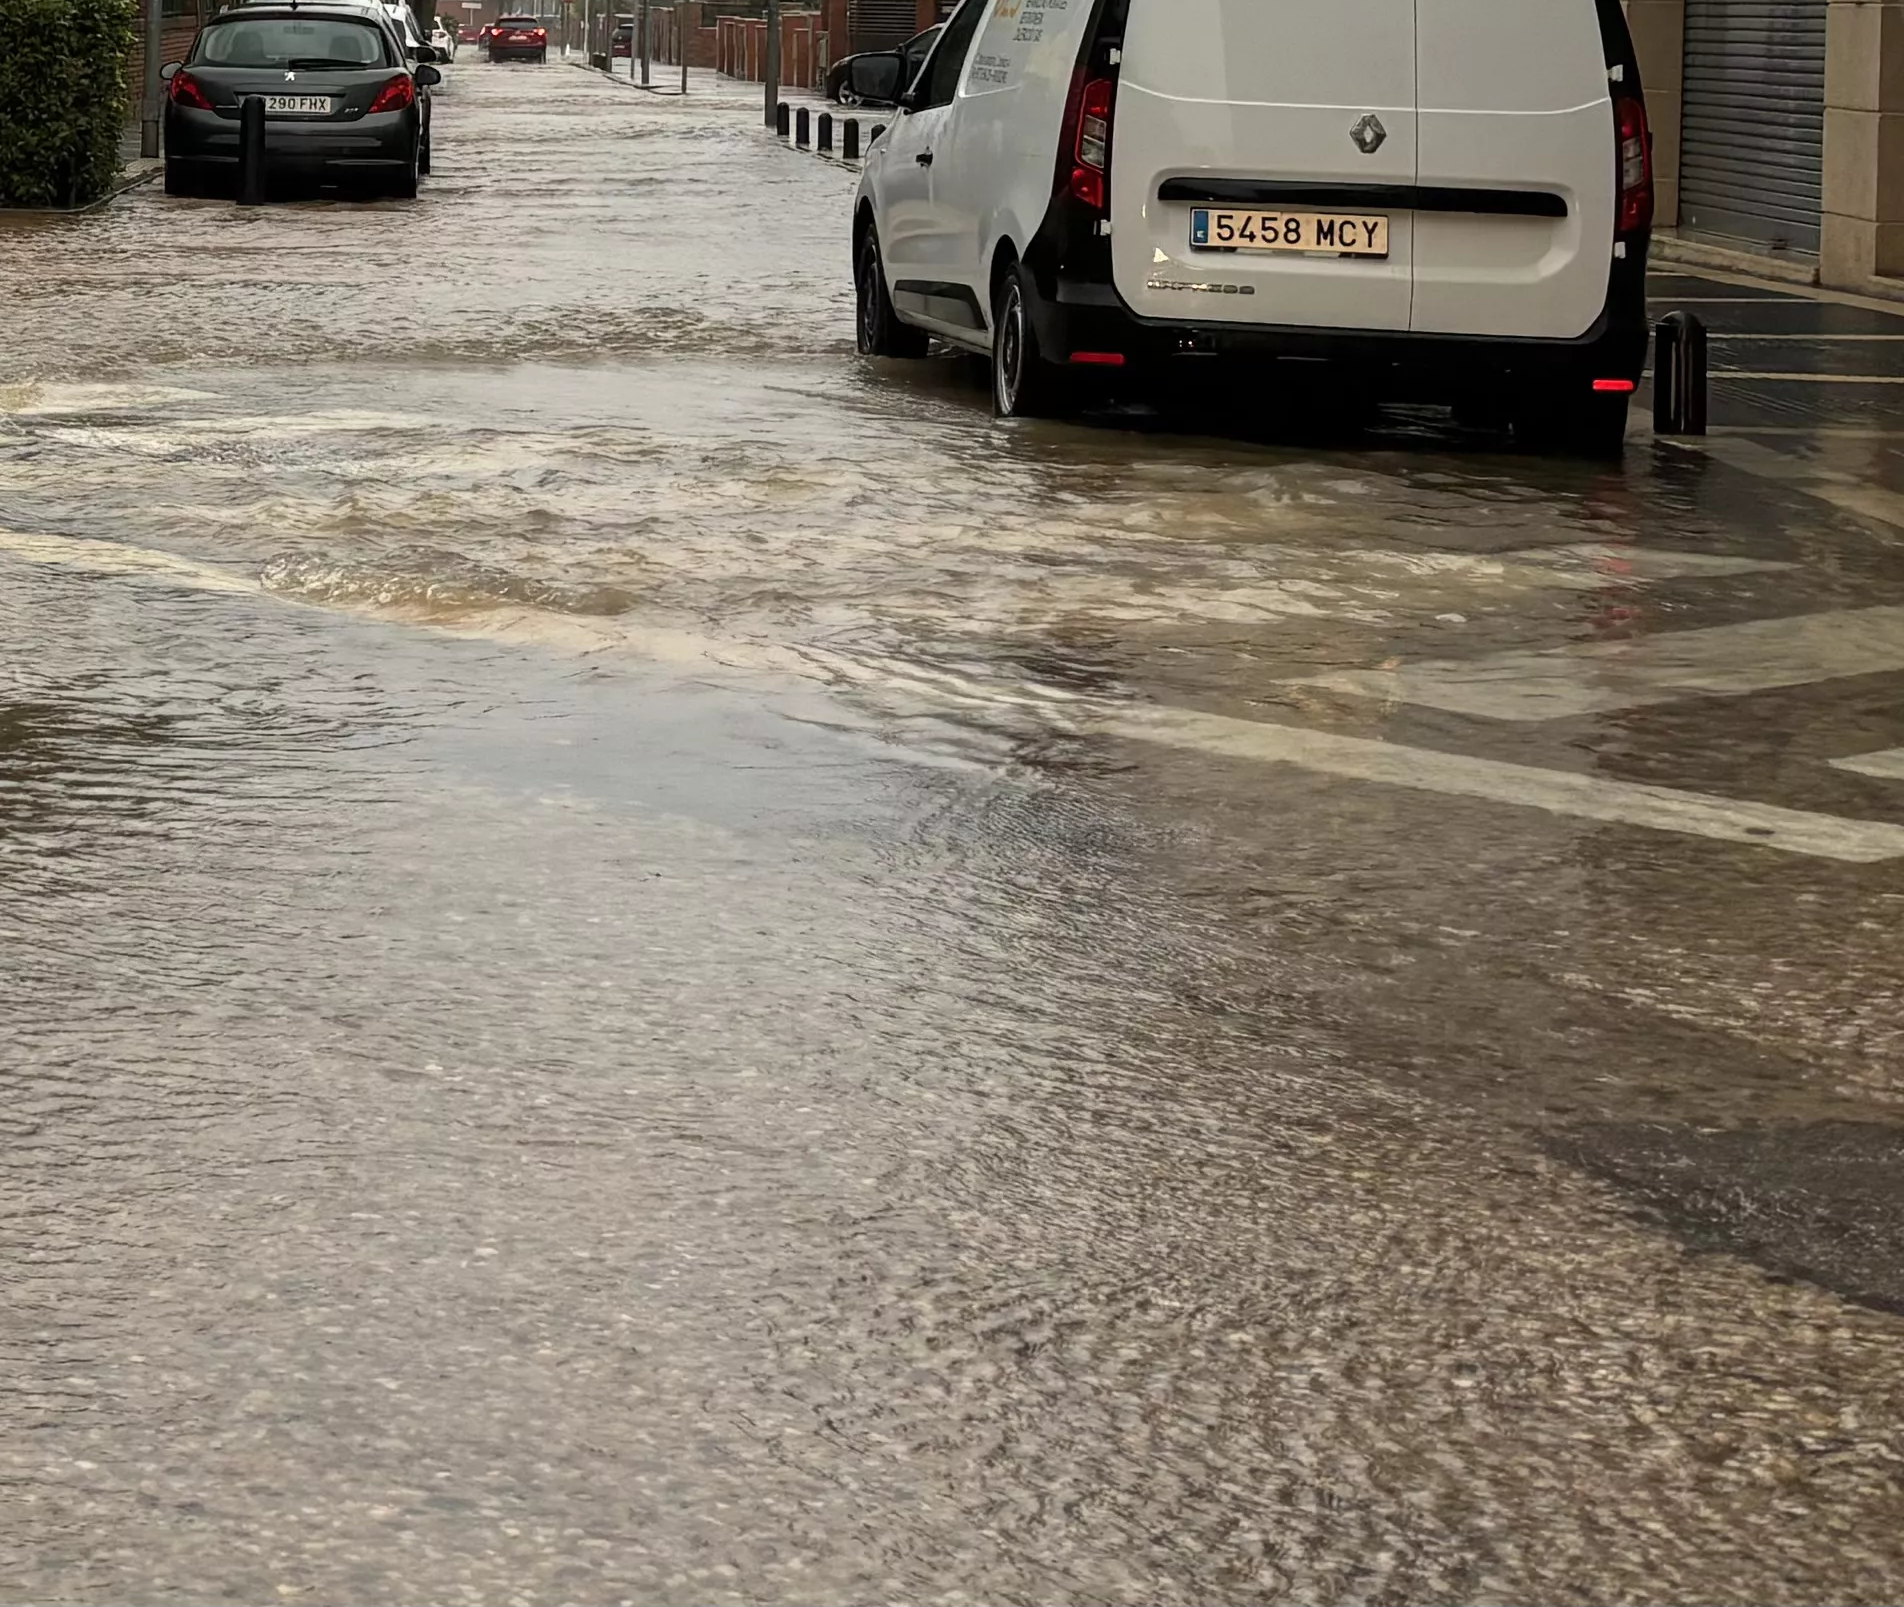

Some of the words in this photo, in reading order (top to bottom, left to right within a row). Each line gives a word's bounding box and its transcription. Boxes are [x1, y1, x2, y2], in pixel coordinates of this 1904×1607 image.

[266, 97, 296, 110] 290
[299, 97, 327, 111] FHX
[1216, 214, 1301, 245] 5458
[1316, 218, 1379, 248] MCY
